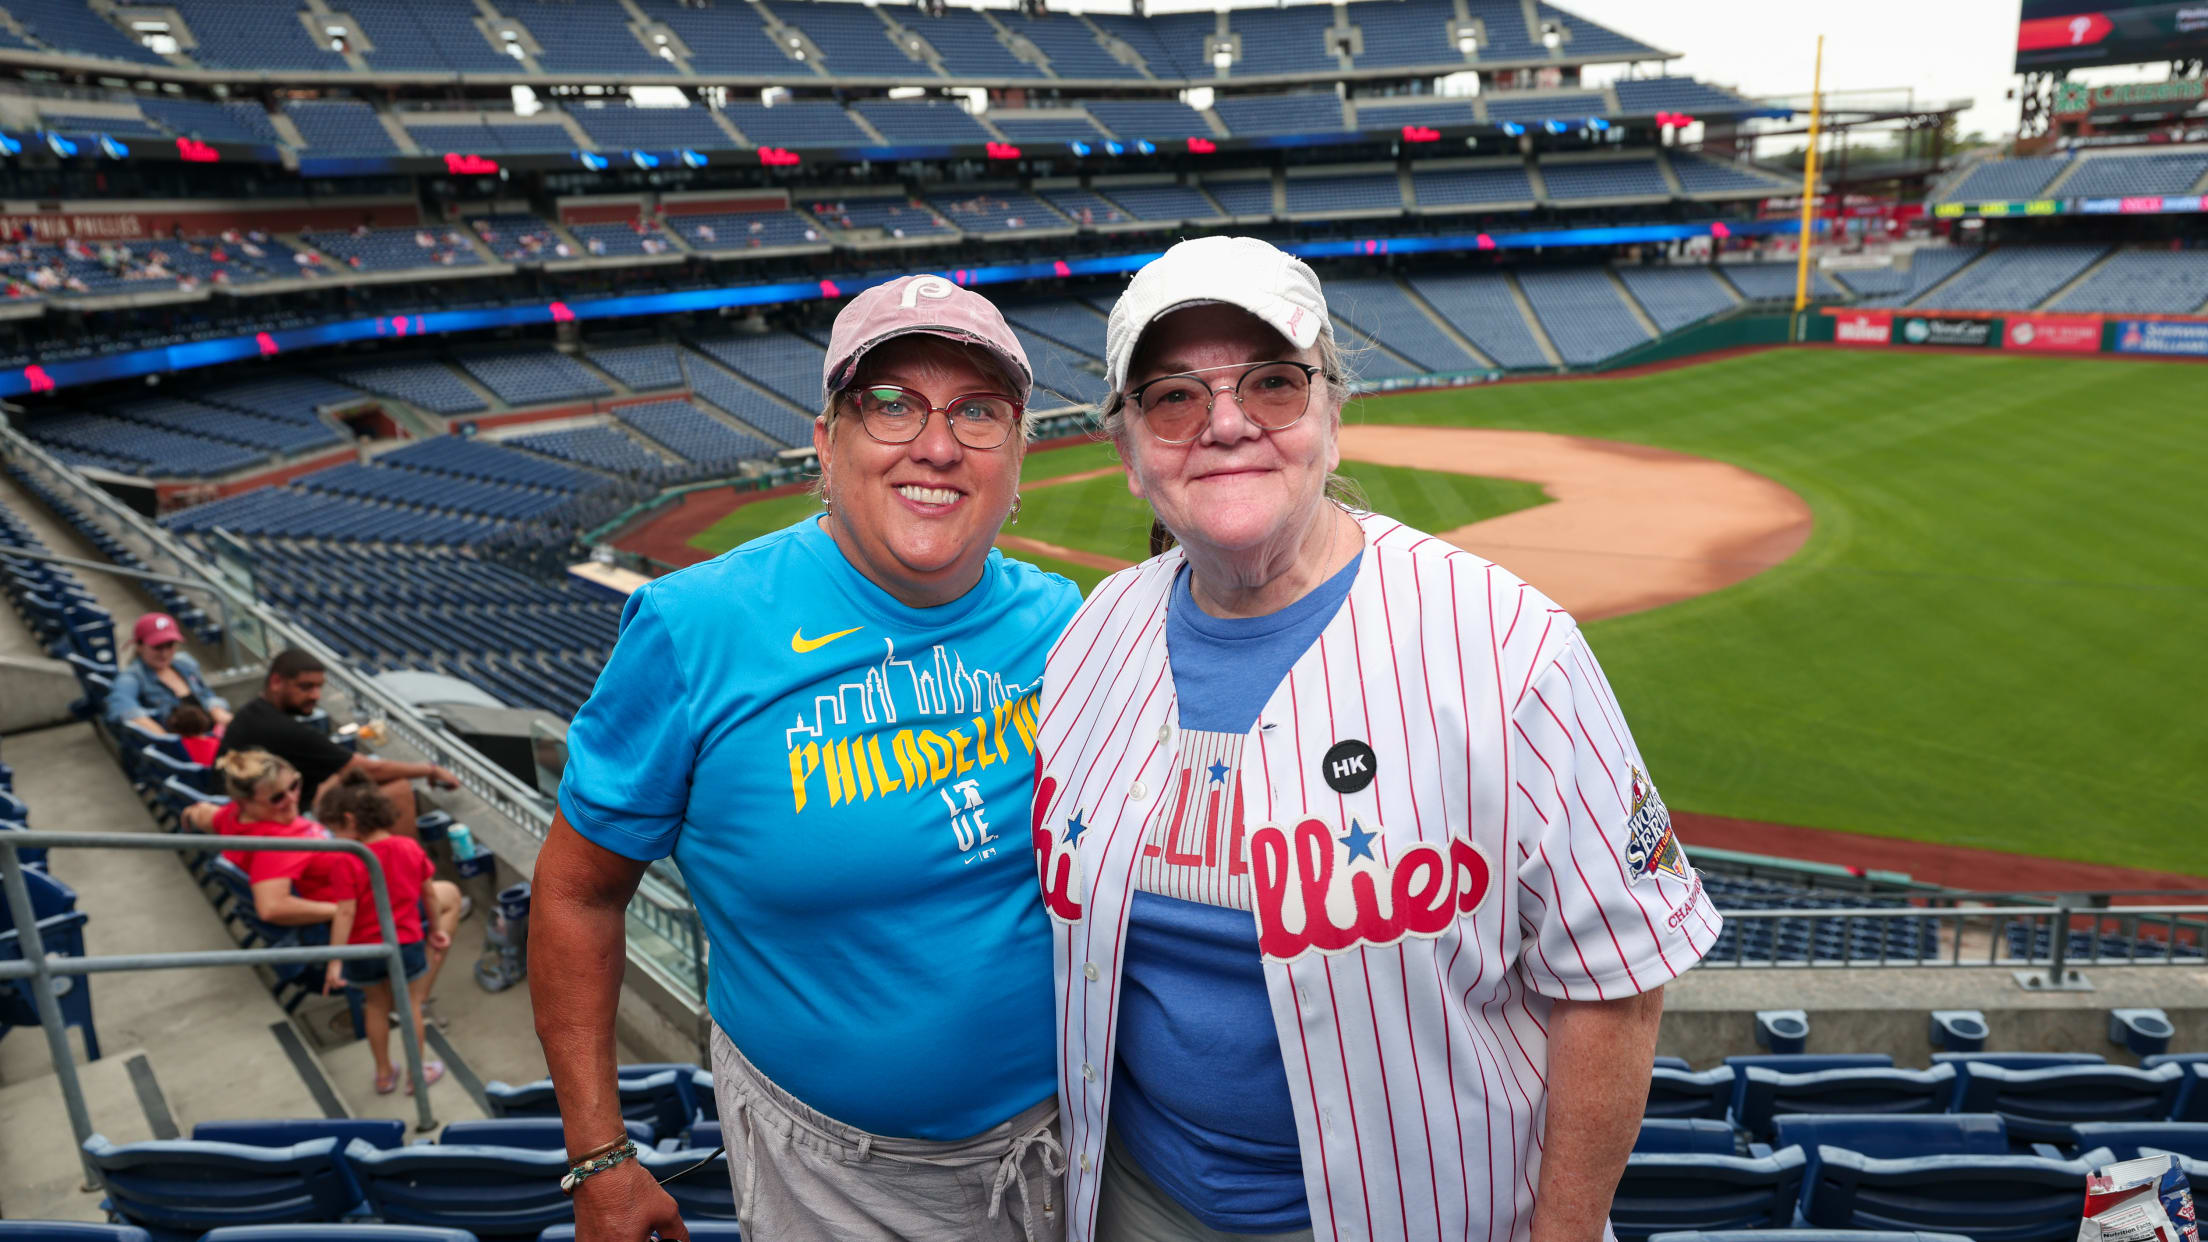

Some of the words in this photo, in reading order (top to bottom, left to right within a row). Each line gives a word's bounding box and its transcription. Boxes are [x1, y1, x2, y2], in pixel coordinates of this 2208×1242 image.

[901, 276, 953, 309] P
[1332, 754, 1368, 779] HK
[2103, 1228, 2136, 1238] Nutrition
